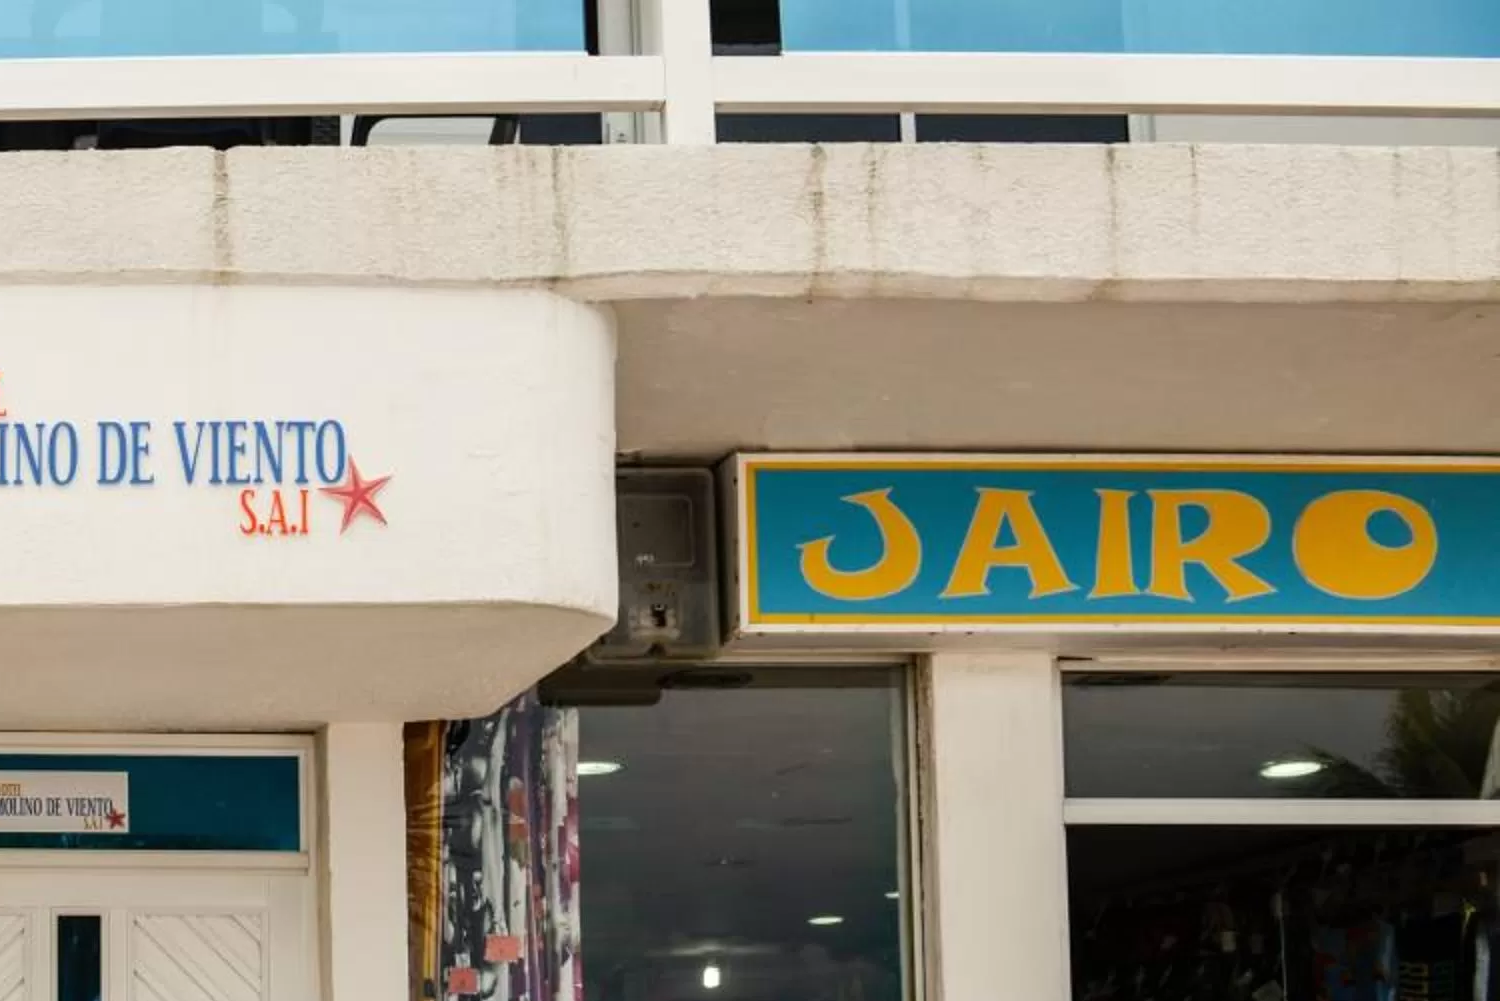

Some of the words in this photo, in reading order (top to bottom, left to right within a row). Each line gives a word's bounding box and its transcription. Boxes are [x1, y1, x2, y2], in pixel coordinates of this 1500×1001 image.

[98, 421, 155, 486] DE
[174, 418, 347, 485] VIENTO
[239, 488, 311, 538] S.A.I
[797, 487, 1438, 602] JAIRO
[46, 797, 62, 817] DE
[65, 797, 113, 817] VIENTO
